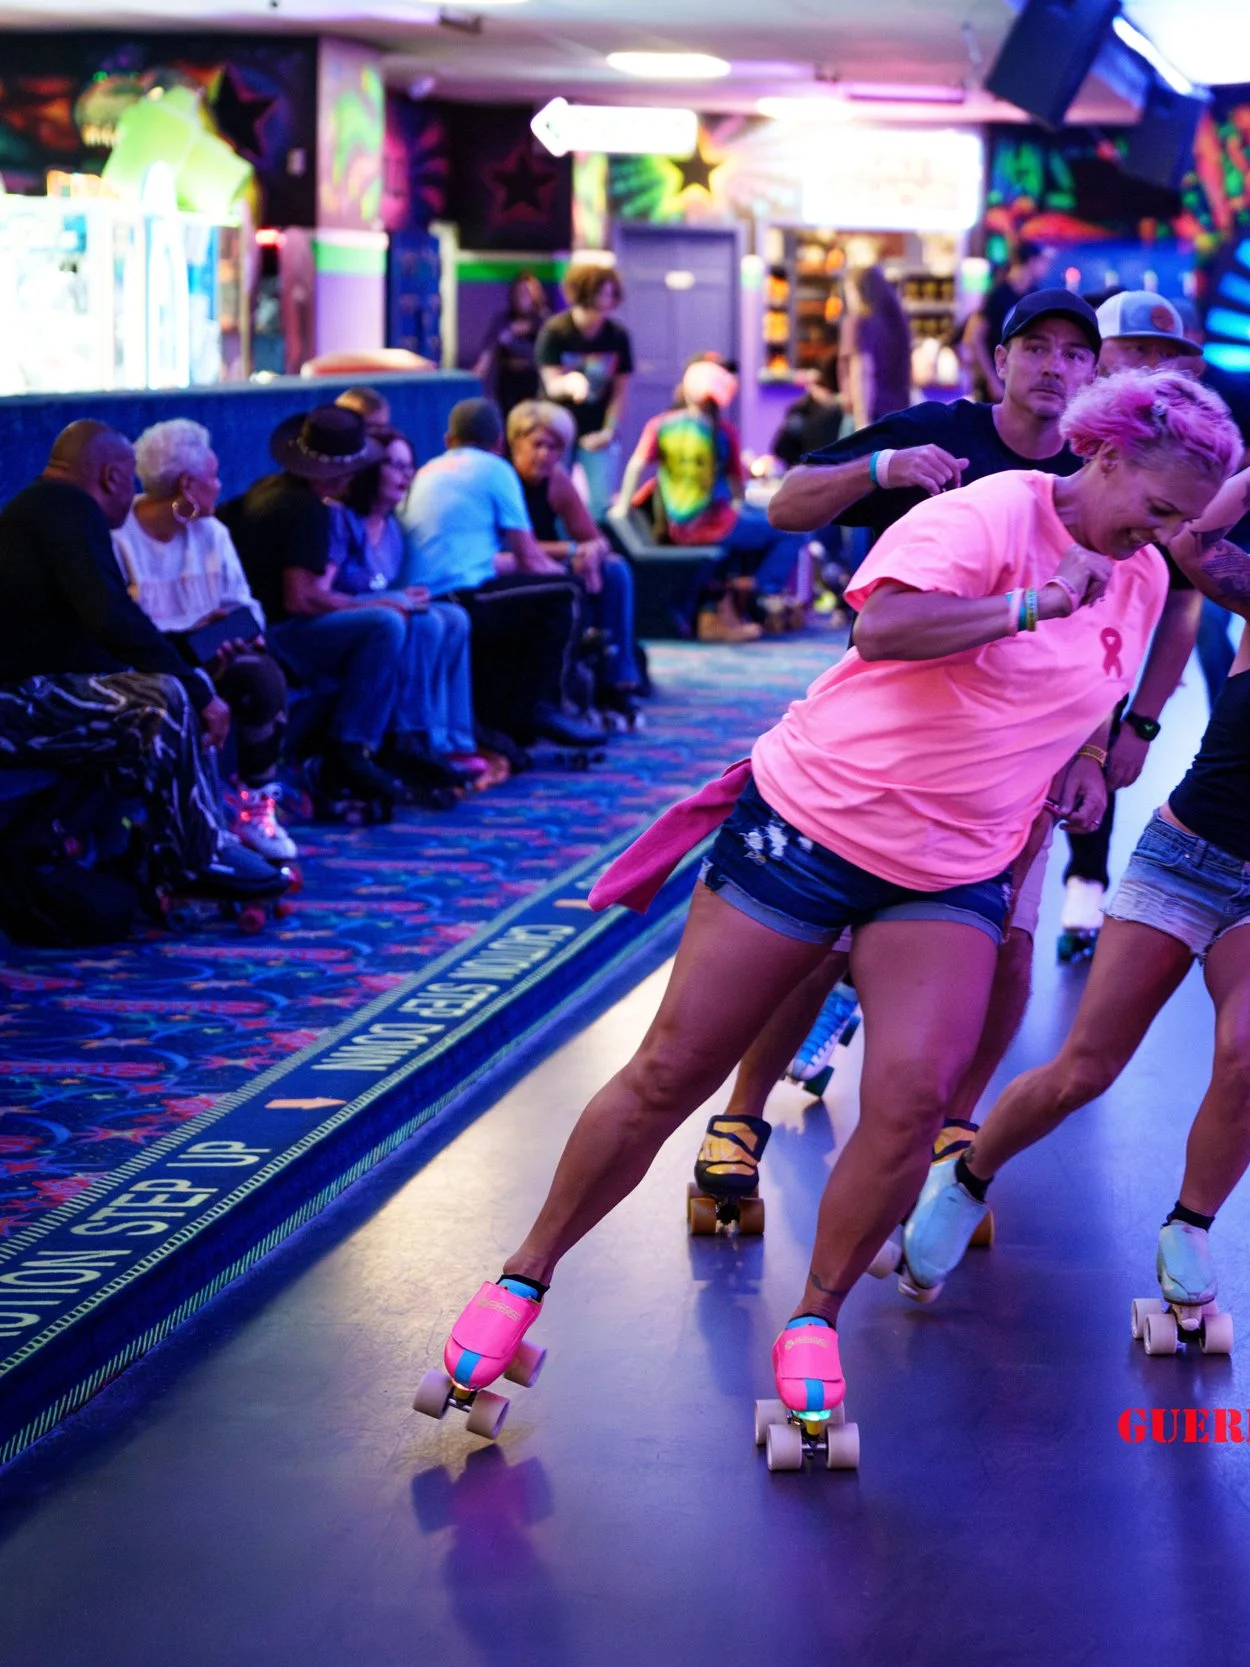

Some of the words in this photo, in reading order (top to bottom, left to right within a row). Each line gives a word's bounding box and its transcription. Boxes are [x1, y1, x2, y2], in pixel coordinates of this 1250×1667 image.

[448, 924, 576, 980] CAUTION
[397, 982, 499, 1018] STEP
[310, 1022, 445, 1071] DOWN
[70, 1178, 219, 1236] STEP
[165, 1140, 271, 1167] UP
